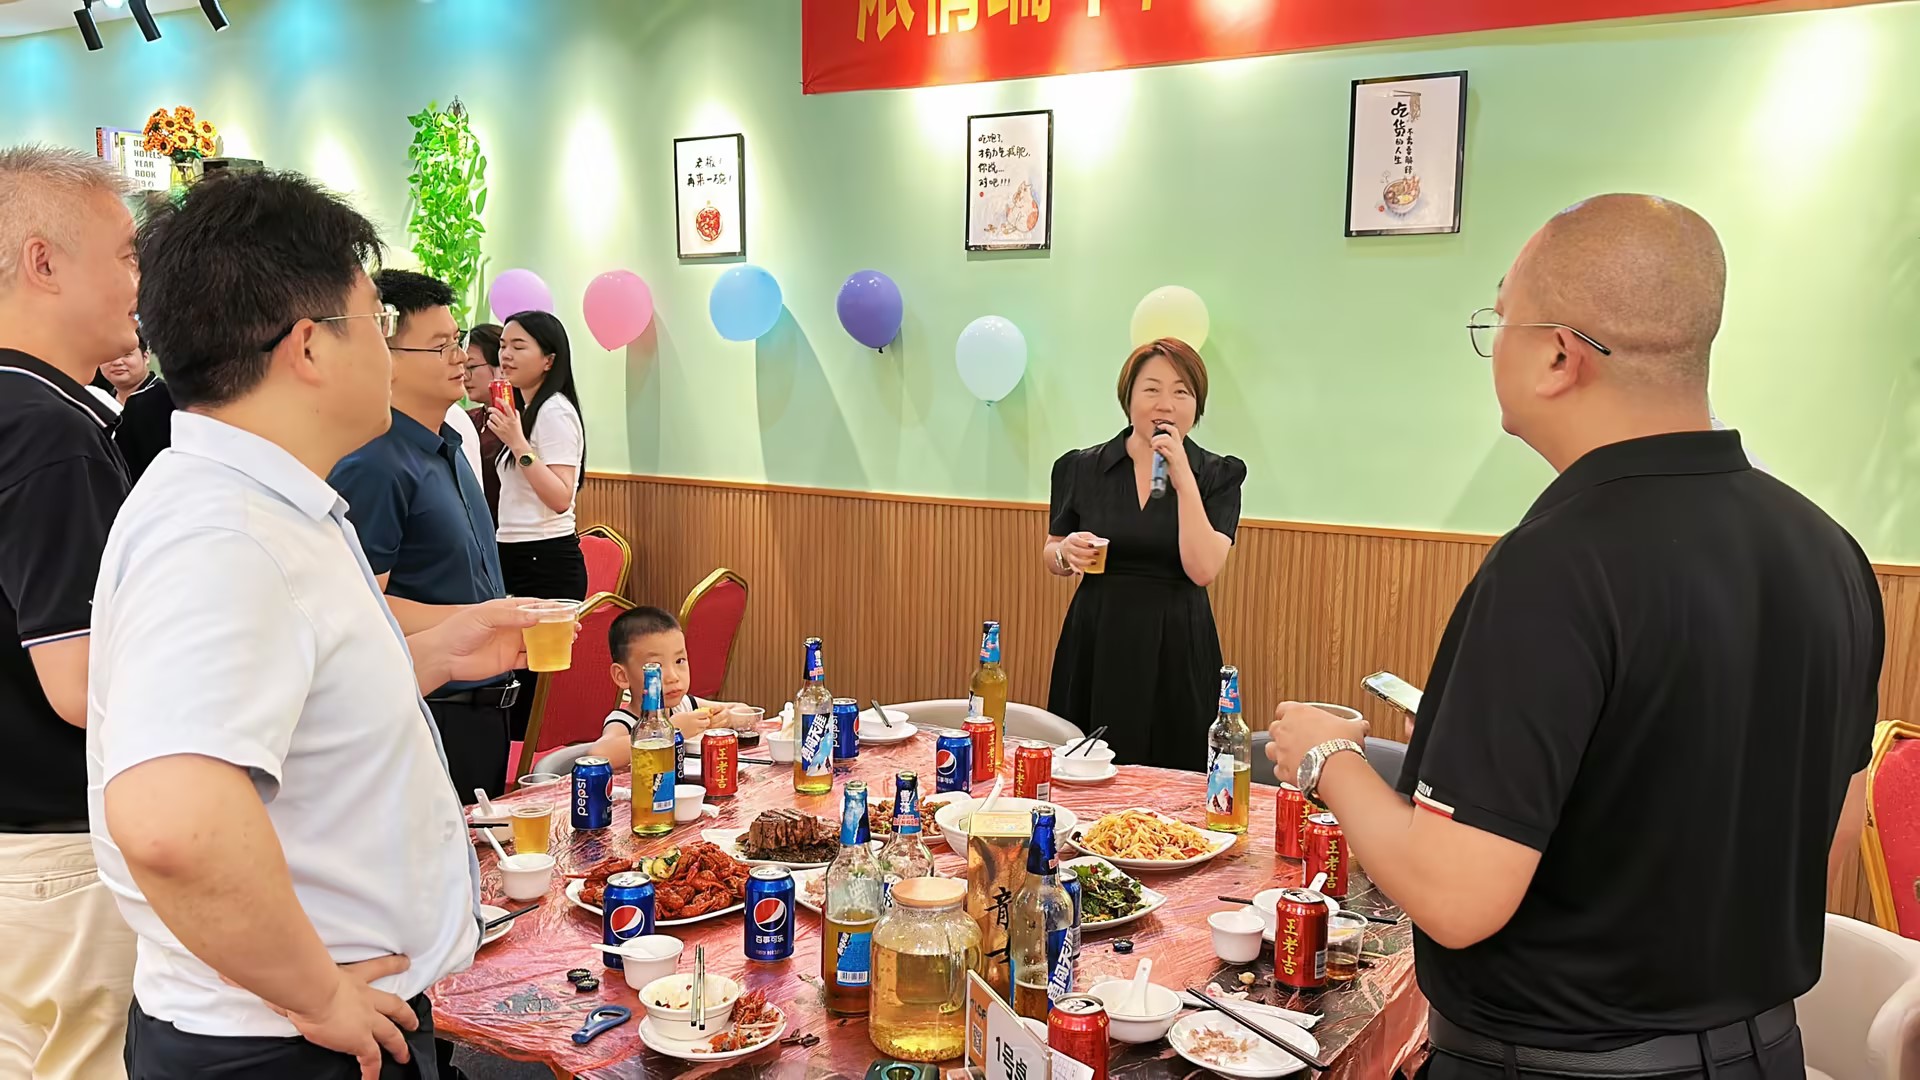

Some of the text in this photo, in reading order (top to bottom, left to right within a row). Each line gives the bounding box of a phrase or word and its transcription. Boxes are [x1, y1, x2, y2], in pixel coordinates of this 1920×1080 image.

[1391, 101, 1409, 165] 吃货的人生
[133, 149, 162, 159] HOTELS
[134, 160, 154, 168] YEAR
[134, 170, 156, 178] BOOK
[716, 748, 729, 789] 王老吉
[576, 777, 589, 817] pepsi
[1325, 840, 1340, 889] 王老吉
[1282, 918, 1299, 976] 王老吉
